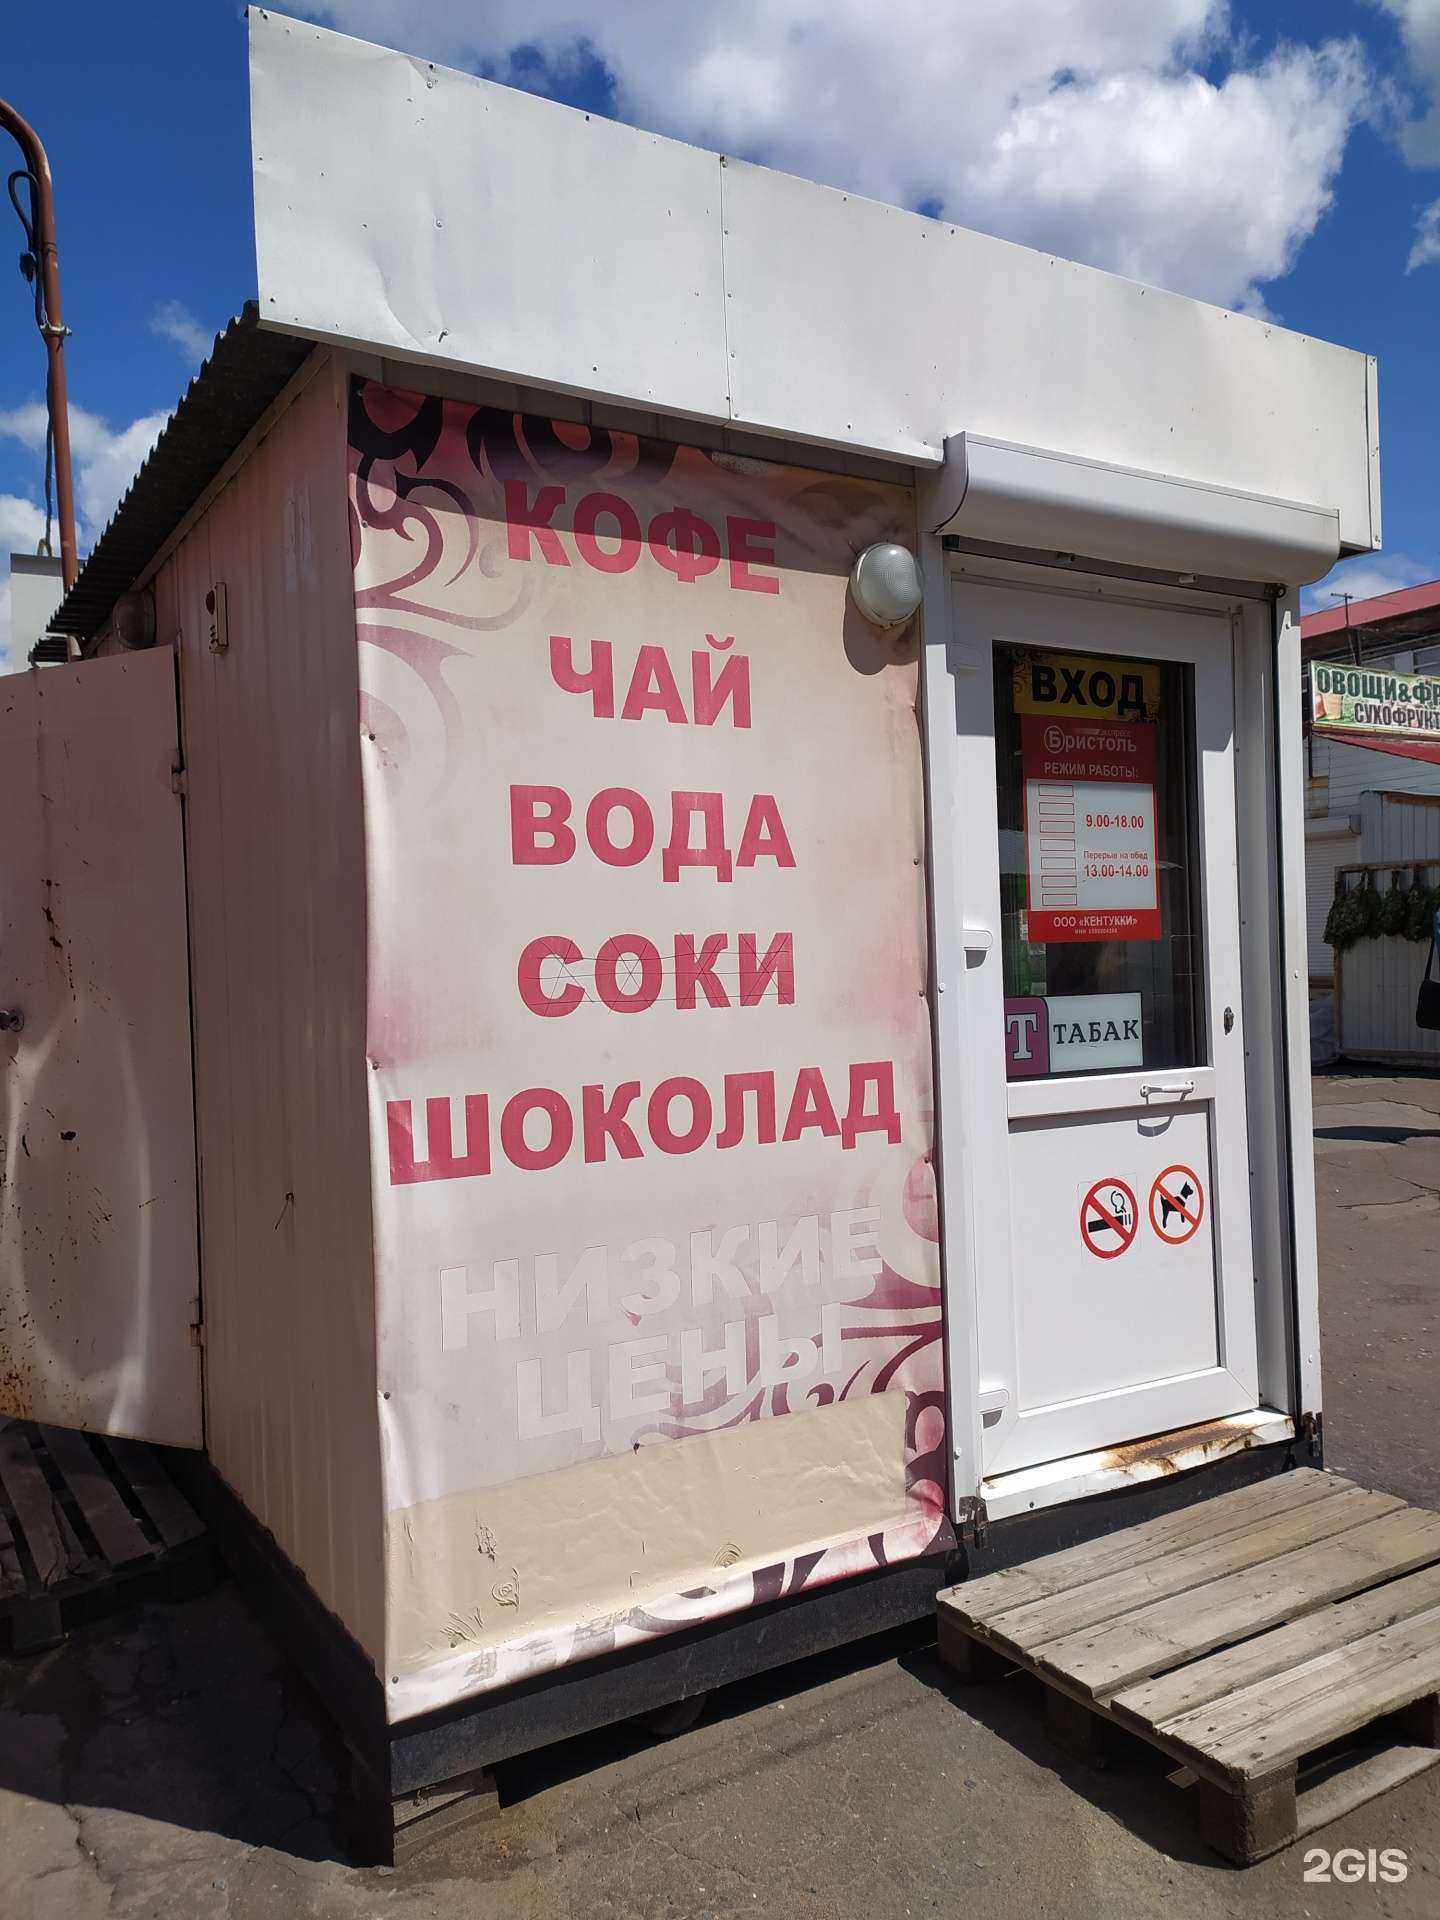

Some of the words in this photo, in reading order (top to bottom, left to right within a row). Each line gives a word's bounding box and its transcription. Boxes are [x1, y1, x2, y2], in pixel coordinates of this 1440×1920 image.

[504, 480, 781, 595] КОФЕ
[549, 634, 752, 729] ЧАЙ
[1031, 665, 1147, 720] ВХОД
[1044, 726, 1137, 754] Бристоль
[1044, 762, 1086, 776] РЕЖИМ
[510, 784, 797, 883] ВОДА
[1086, 814, 1144, 829] 9.00-18.00
[1083, 850, 1118, 861] Перерыв
[1119, 852, 1129, 860] на
[1130, 850, 1148, 860] обед
[1084, 864, 1149, 877] 13.00-14.00
[1053, 916, 1076, 928] ООО
[1079, 914, 1137, 927] «КЕНТУККИ»
[517, 932, 795, 1017] СОКИ
[1006, 1013, 1038, 1060] Т
[1053, 1019, 1140, 1045] ТАБАК
[387, 1061, 902, 1185] ШОКОЛАД
[439, 1205, 884, 1353] НИЗКИЕ
[515, 1302, 842, 1443] ЦЕНЫ
